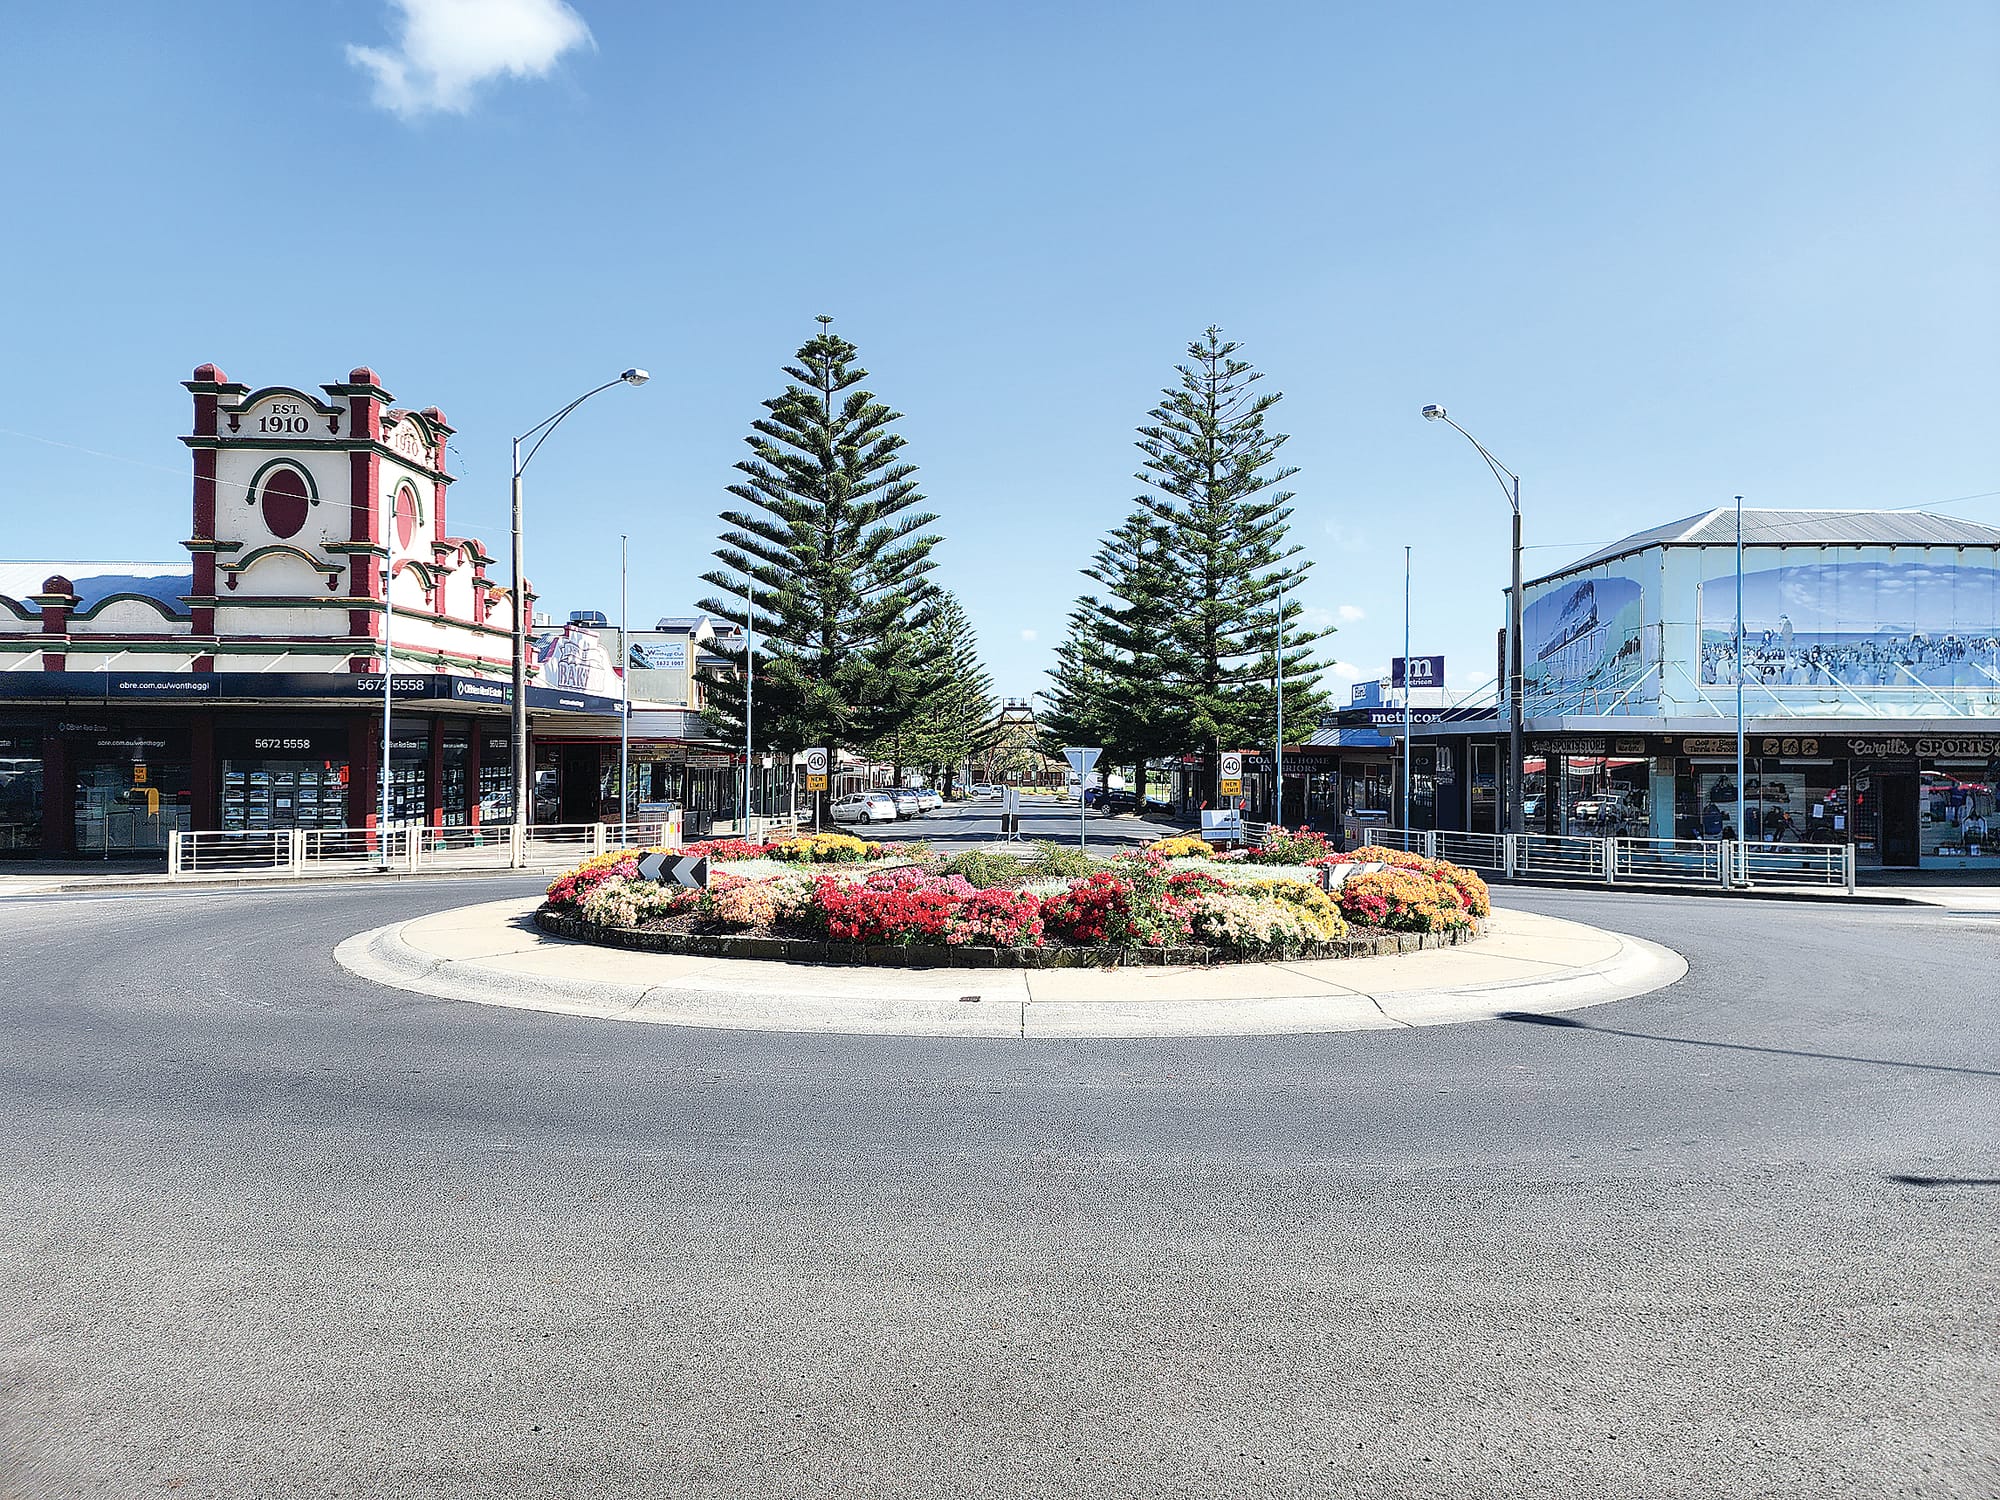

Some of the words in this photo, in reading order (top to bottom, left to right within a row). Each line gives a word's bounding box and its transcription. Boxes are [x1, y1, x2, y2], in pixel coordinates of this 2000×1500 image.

[259, 416, 309, 433] 1910
[357, 679, 387, 691] 5672
[392, 679, 425, 691] 5558
[255, 739, 280, 748] 5672
[283, 739, 310, 748] 5558
[1551, 738, 1580, 753] SPORTS
[1580, 738, 1606, 753] STORE
[1848, 738, 1913, 759] Cargill's
[1915, 738, 1994, 757] SPORTS
[810, 756, 824, 767] 40
[1225, 761, 1238, 771] 40
[1248, 756, 1296, 764] COAAL
[1298, 756, 1330, 765] HOME
